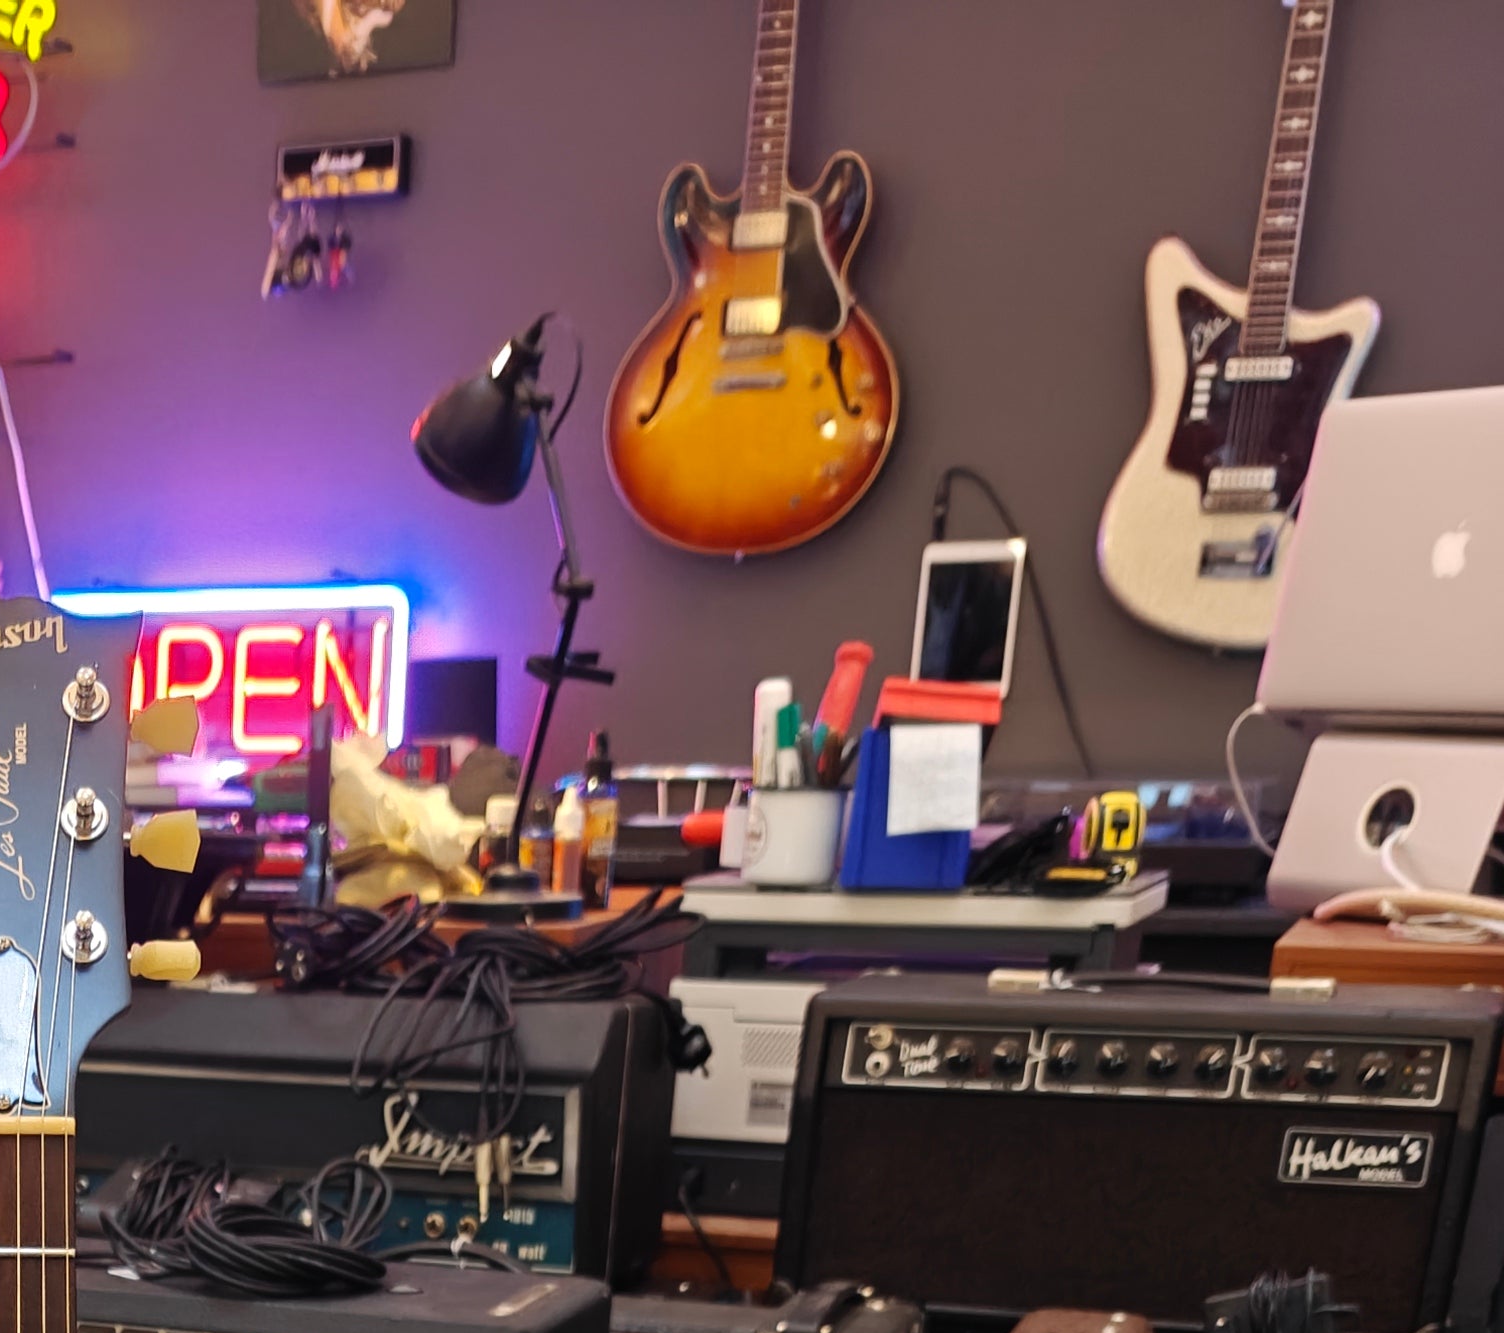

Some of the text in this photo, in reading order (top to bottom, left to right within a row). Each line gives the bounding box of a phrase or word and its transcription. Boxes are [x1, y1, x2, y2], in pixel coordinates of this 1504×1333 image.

[129, 617, 391, 753] PEN
[14, 721, 28, 766] MODEL
[1287, 1133, 1423, 1181] Halkan's
